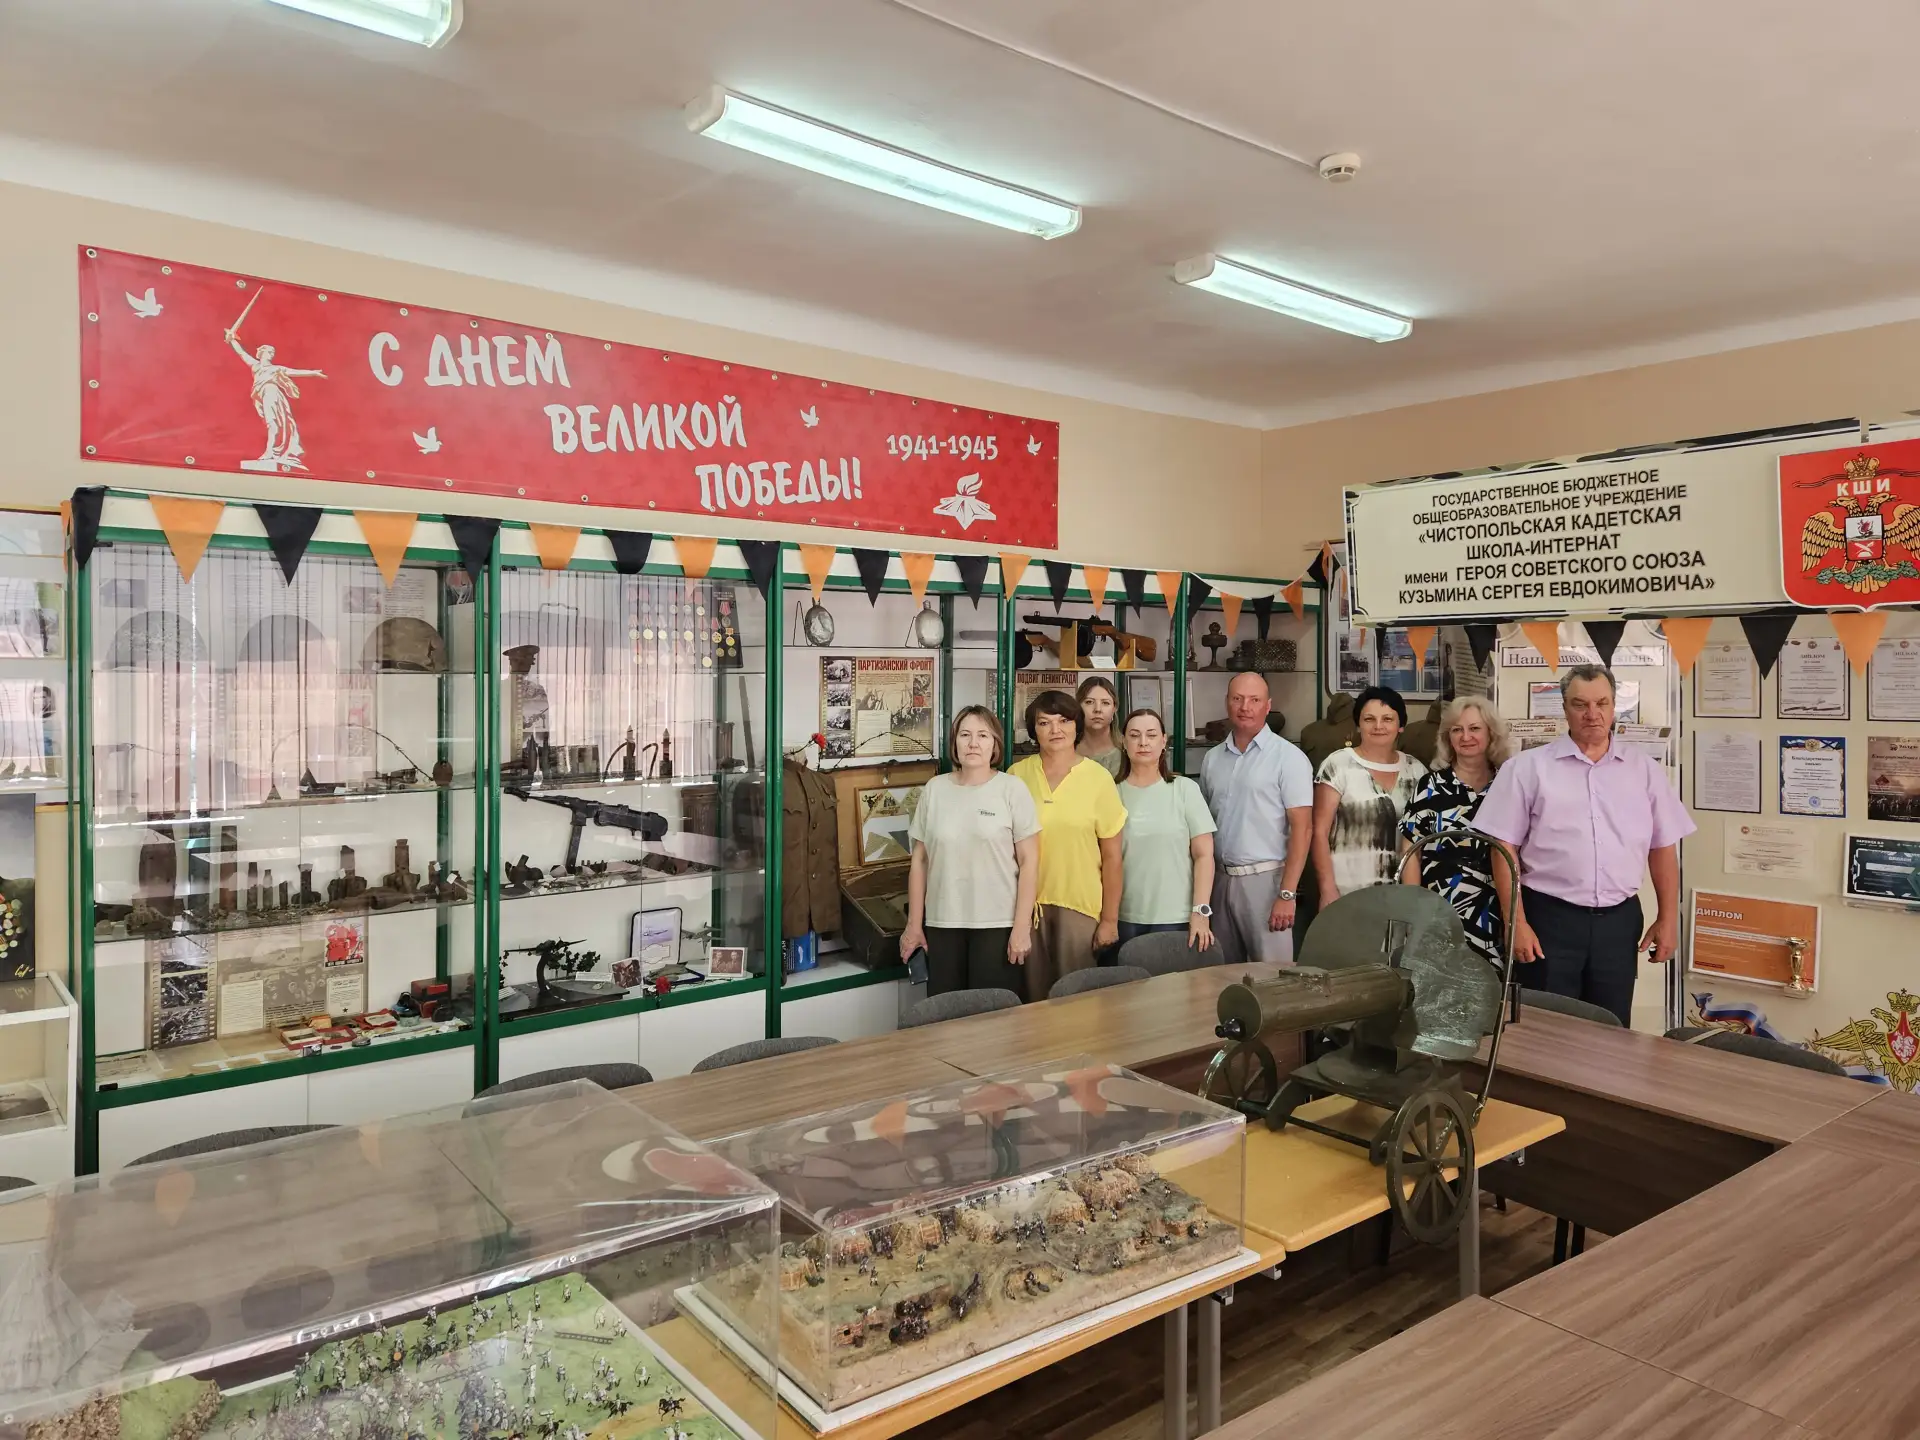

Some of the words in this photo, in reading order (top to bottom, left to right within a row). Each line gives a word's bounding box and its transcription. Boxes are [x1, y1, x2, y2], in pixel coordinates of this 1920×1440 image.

[368, 332, 403, 387] С
[424, 333, 571, 388] ДНЕМ
[543, 394, 747, 454] ВЕЛИКОЙ
[886, 434, 999, 462] 1941-1945
[695, 457, 863, 510] ПОБЕДЫ!
[1432, 481, 1559, 507] ГОСУДАРСТВЕННОЕ
[1563, 469, 1660, 493] БЮДЖЕТНОЕ
[1837, 478, 1890, 497] КШИ
[1413, 496, 1580, 525] ОБЩЕОБРАЗОВАТЕЛЬНОЕ
[1584, 485, 1687, 508] УЧРЕЖДЕНИЕ
[1418, 516, 1566, 544] «ЧИСТОПОЛЬСКАЯ
[1572, 505, 1682, 531] КАДЕТСКАЯ
[1466, 534, 1621, 560] ШКОЛА-ИНТЕРНАТ
[1405, 571, 1448, 585] имени
[1456, 564, 1507, 581] ГЕРОЯ
[1511, 555, 1627, 578] СОВЕТСКОГО
[1632, 550, 1706, 570] СОЮЗА
[1399, 587, 1478, 605] КУЗЬМИНА
[1482, 583, 1544, 600] СЕРГЕЯ
[1550, 573, 1715, 599] ЕВДОКИМОВИЧА»
[858, 659, 908, 671] ПАРТИЗАНСКИЙ
[910, 660, 932, 671] ФРОНТ
[1509, 653, 1545, 665] Наш
[1017, 673, 1039, 685] ПОДВИГ
[1041, 673, 1076, 685] ЛЕНИНГРАДА
